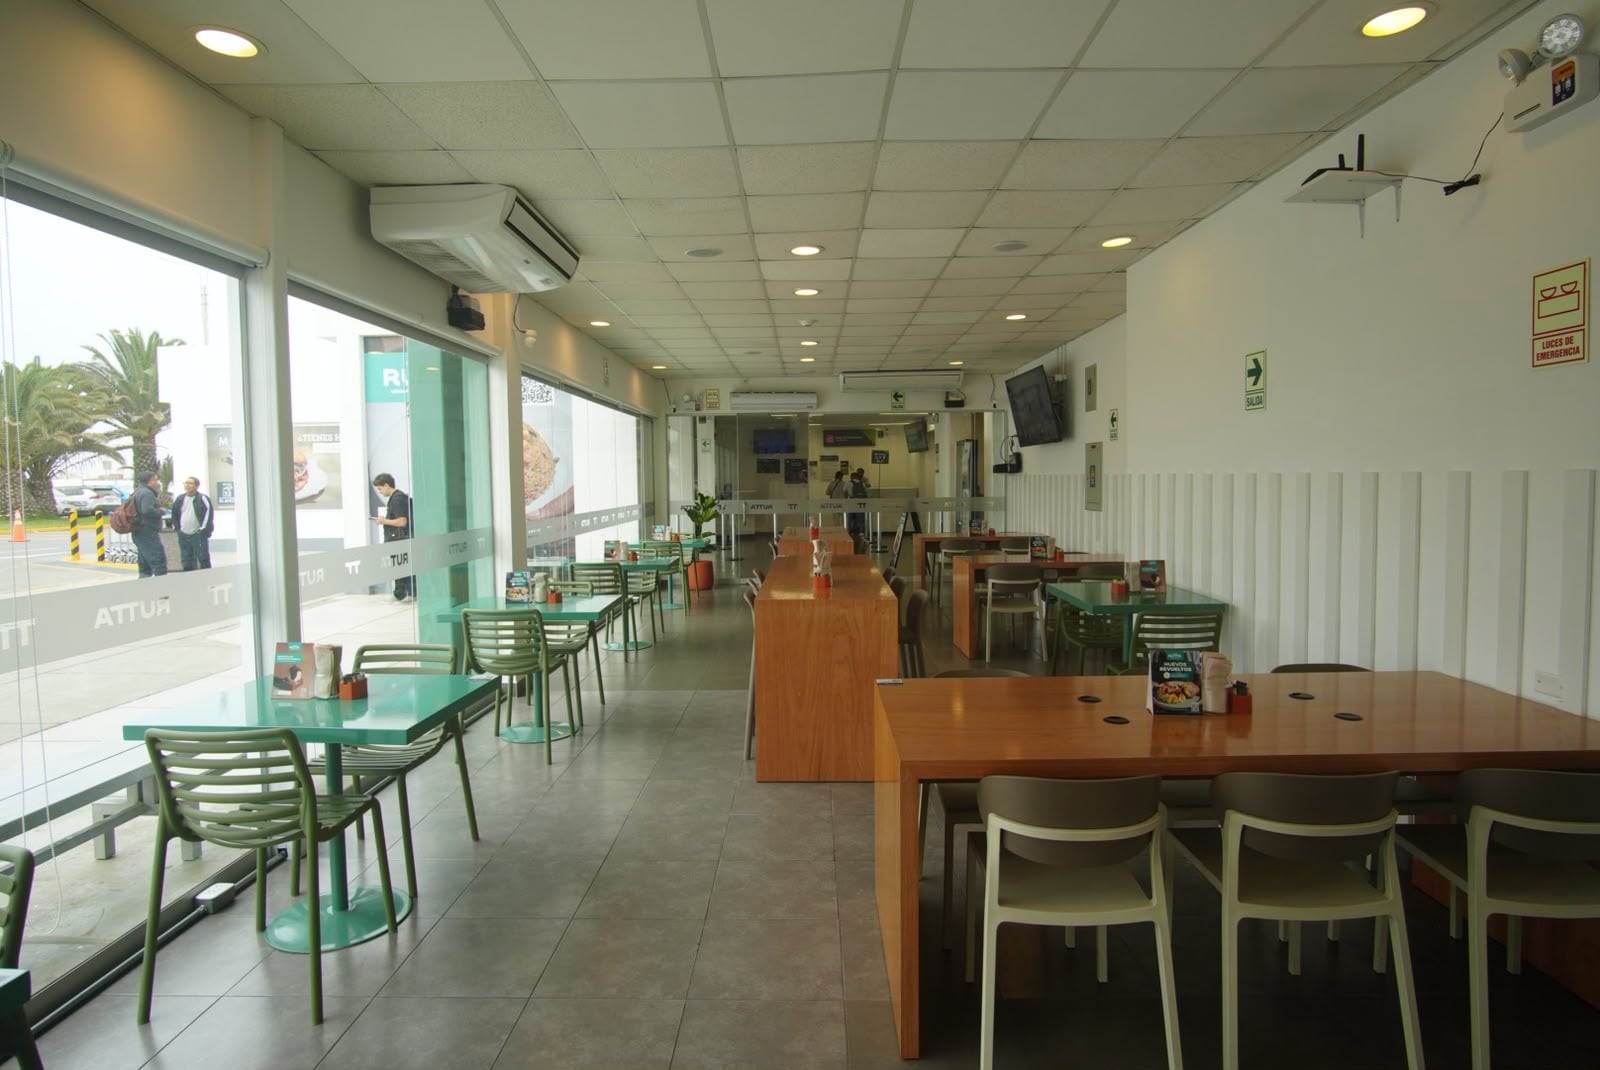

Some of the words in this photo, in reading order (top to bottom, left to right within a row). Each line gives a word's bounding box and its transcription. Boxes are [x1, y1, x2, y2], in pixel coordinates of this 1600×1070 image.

[1542, 339, 1563, 350] LUCES
[1565, 335, 1574, 345] DE
[1536, 345, 1580, 361] EMERGENCIA
